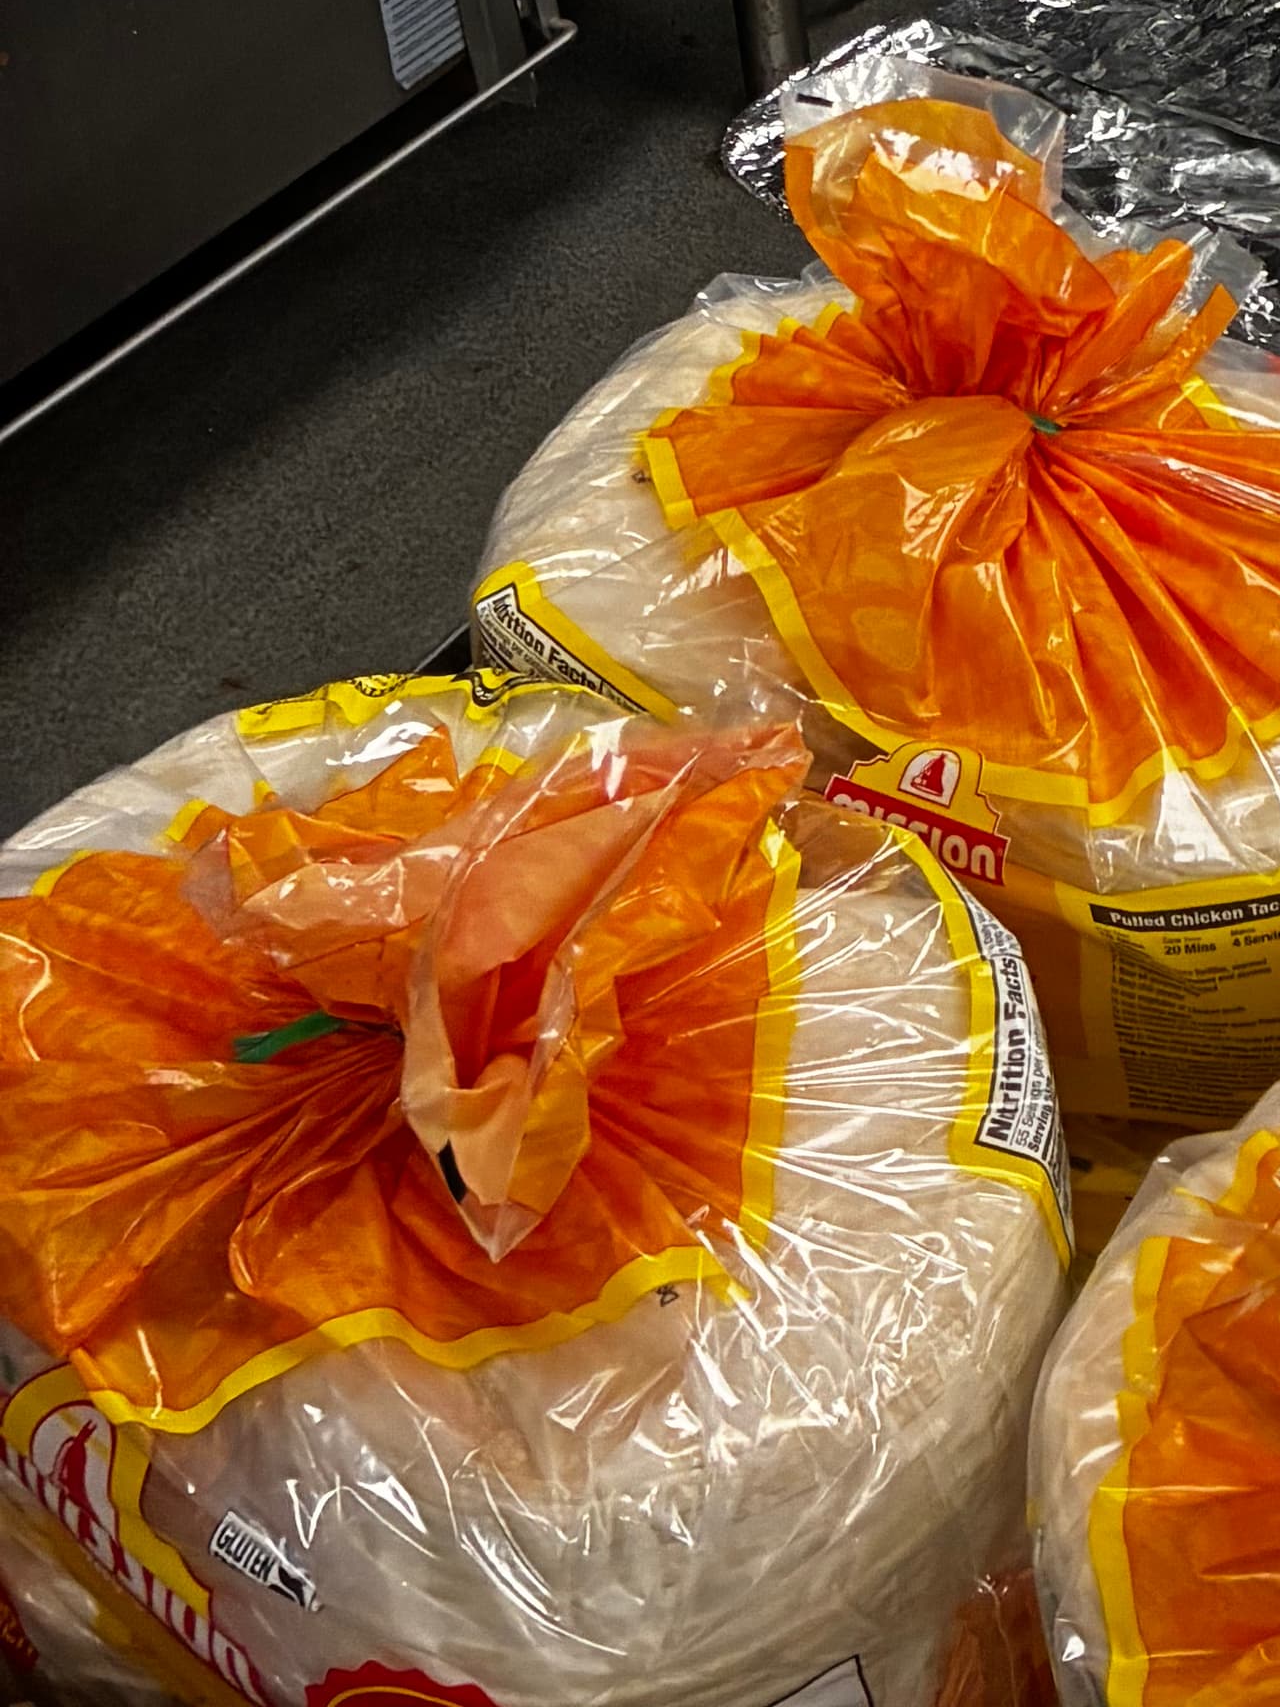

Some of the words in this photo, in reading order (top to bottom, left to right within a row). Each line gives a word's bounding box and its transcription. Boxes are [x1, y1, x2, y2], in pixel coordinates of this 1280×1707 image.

[1109, 911, 1165, 928] Pulled
[1170, 908, 1244, 927] Chicken
[1164, 944, 1181, 956] 20
[1000, 957, 1026, 1021] Facts
[215, 1523, 276, 1583] GLUTEN
